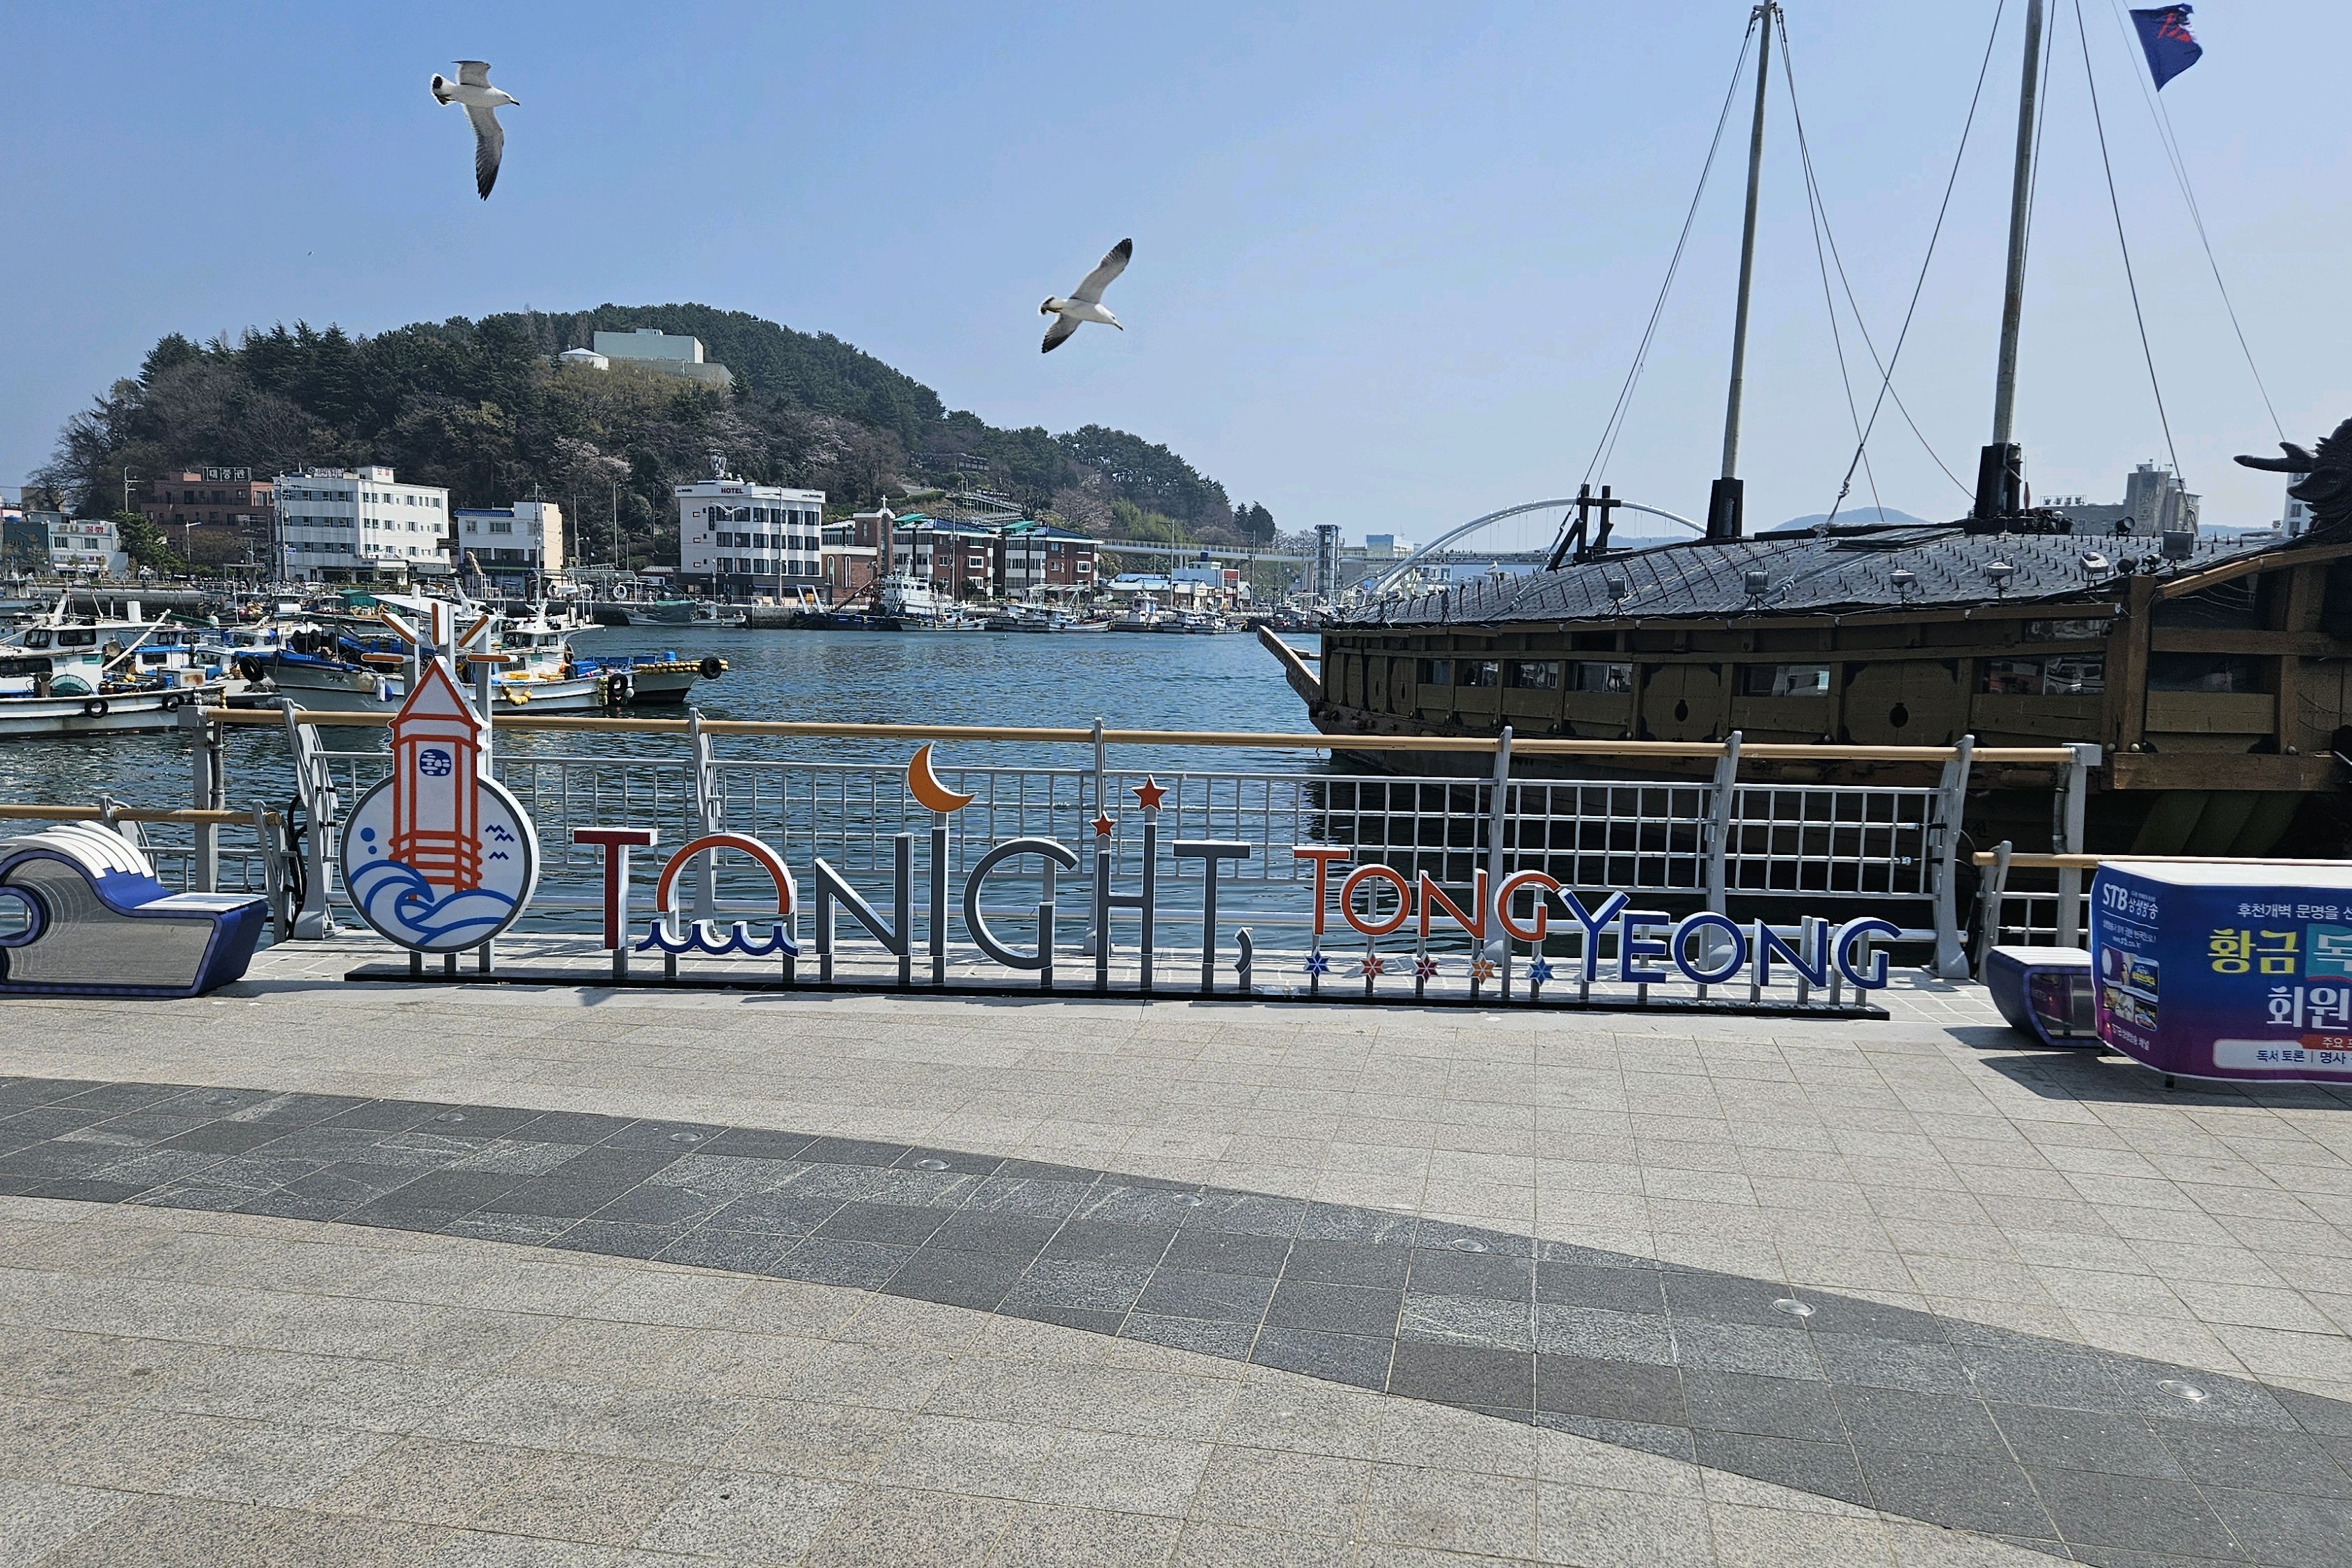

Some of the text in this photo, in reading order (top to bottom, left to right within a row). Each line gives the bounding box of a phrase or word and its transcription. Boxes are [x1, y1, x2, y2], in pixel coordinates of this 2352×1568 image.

[2103, 882, 2128, 911] STB
[2237, 903, 2291, 918] 후천개벽
[2296, 904, 2339, 920] 문명을
[2207, 928, 2300, 974] 황금
[2266, 985, 2350, 1030] 회원
[2322, 1037, 2344, 1049] 주요
[2257, 1050, 2279, 1063] 독서
[2282, 1050, 2305, 1063] 토론
[2320, 1051, 2346, 1065] 명사
